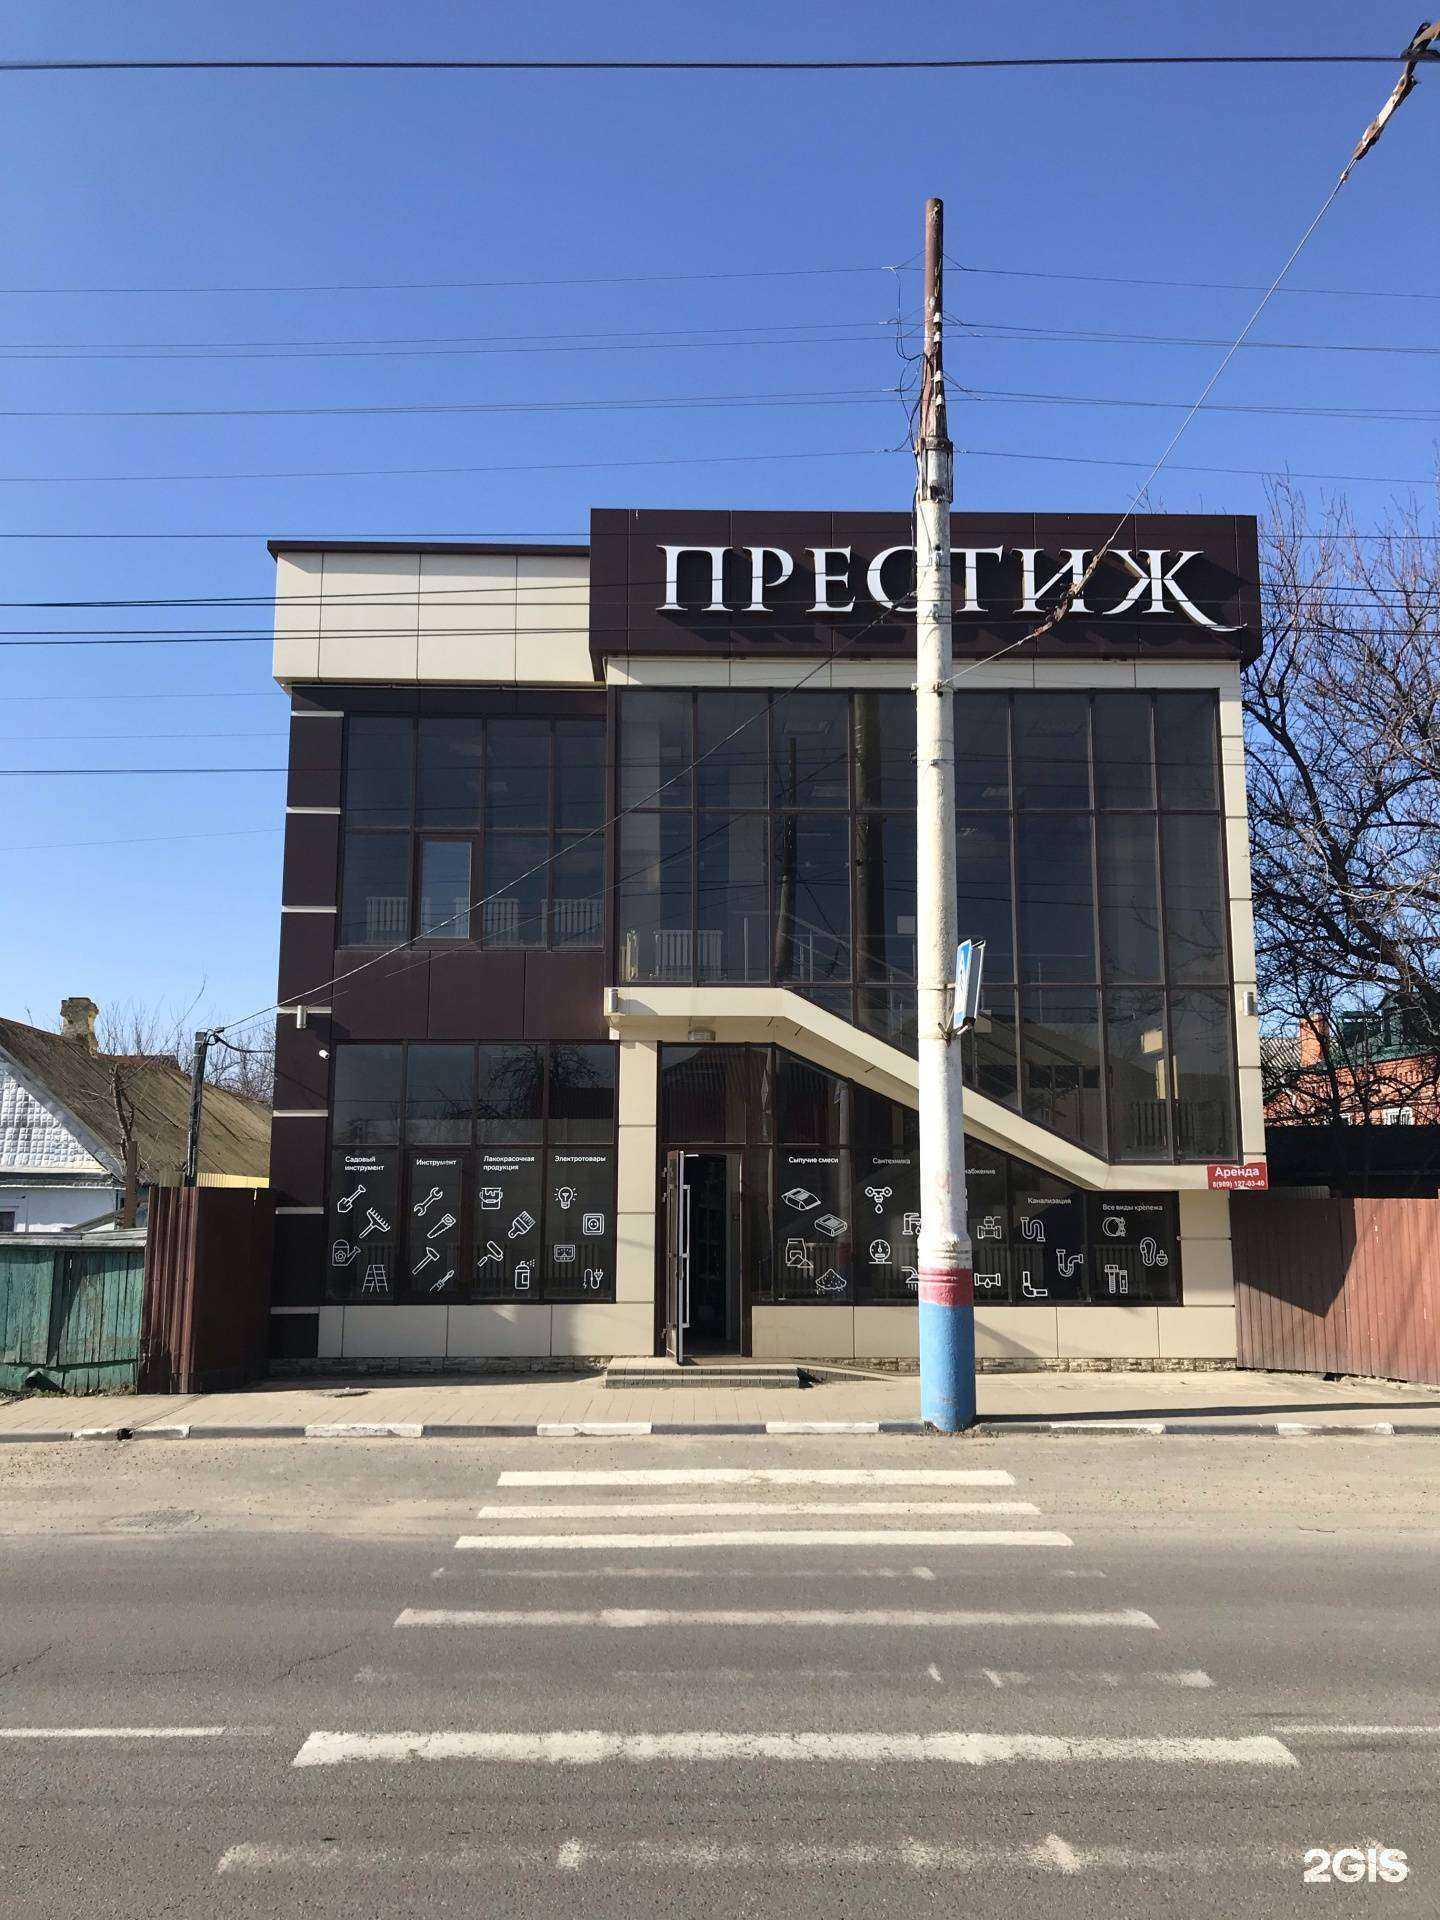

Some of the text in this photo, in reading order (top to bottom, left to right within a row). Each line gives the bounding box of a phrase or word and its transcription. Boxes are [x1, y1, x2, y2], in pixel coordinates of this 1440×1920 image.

[656, 545, 1248, 632] ПРЕСТИЖ
[344, 1155, 376, 1164] Садовый
[416, 1159, 457, 1167] Инструмент
[483, 1155, 535, 1163] Лакокрасочная
[554, 1155, 606, 1163] Электротовары
[788, 1156, 818, 1164] Сыпучие
[872, 1157, 911, 1165] Сантехника
[1214, 1166, 1260, 1179] Аренда
[1027, 1196, 1072, 1205] Канализация
[1102, 1203, 1115, 1211] Все
[1134, 1204, 1163, 1212] крепежа
